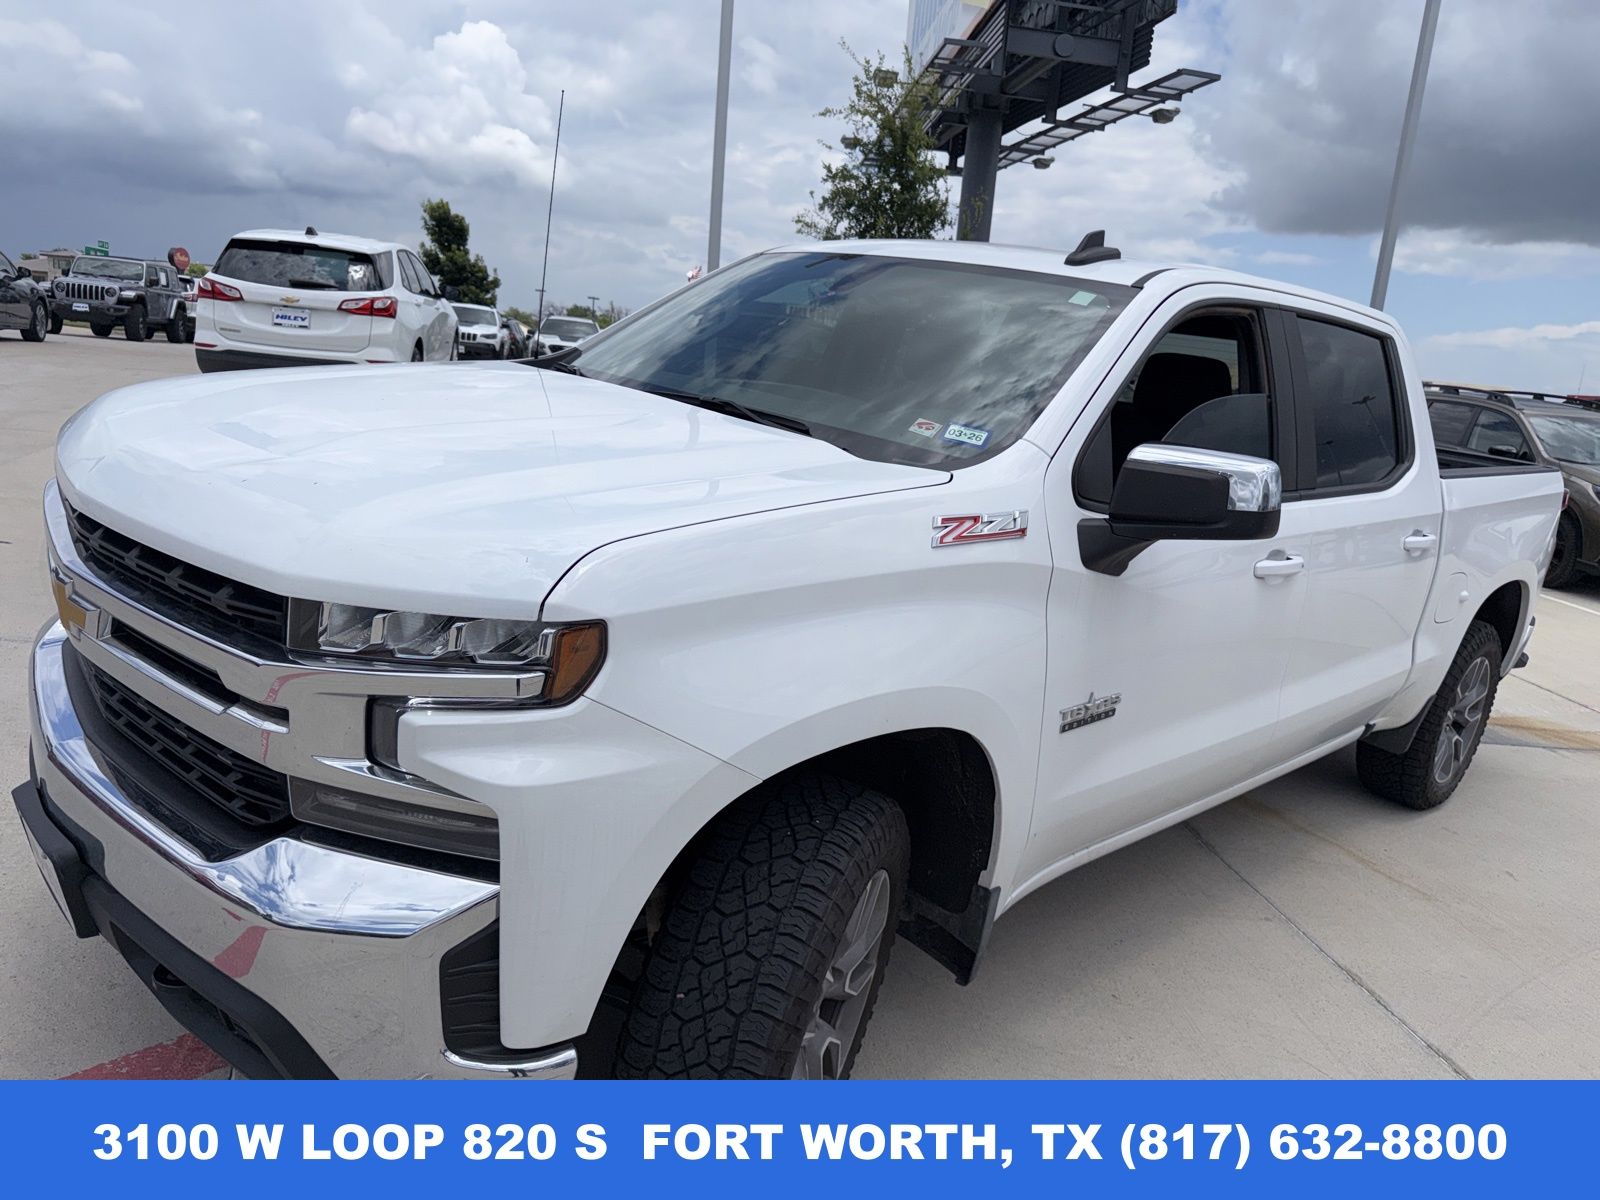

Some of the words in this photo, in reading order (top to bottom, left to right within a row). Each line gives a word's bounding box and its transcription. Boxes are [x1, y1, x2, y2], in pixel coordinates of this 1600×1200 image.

[275, 313, 308, 322] HILEY
[931, 510, 1029, 549] Z71
[1059, 692, 1122, 722] TEXAS
